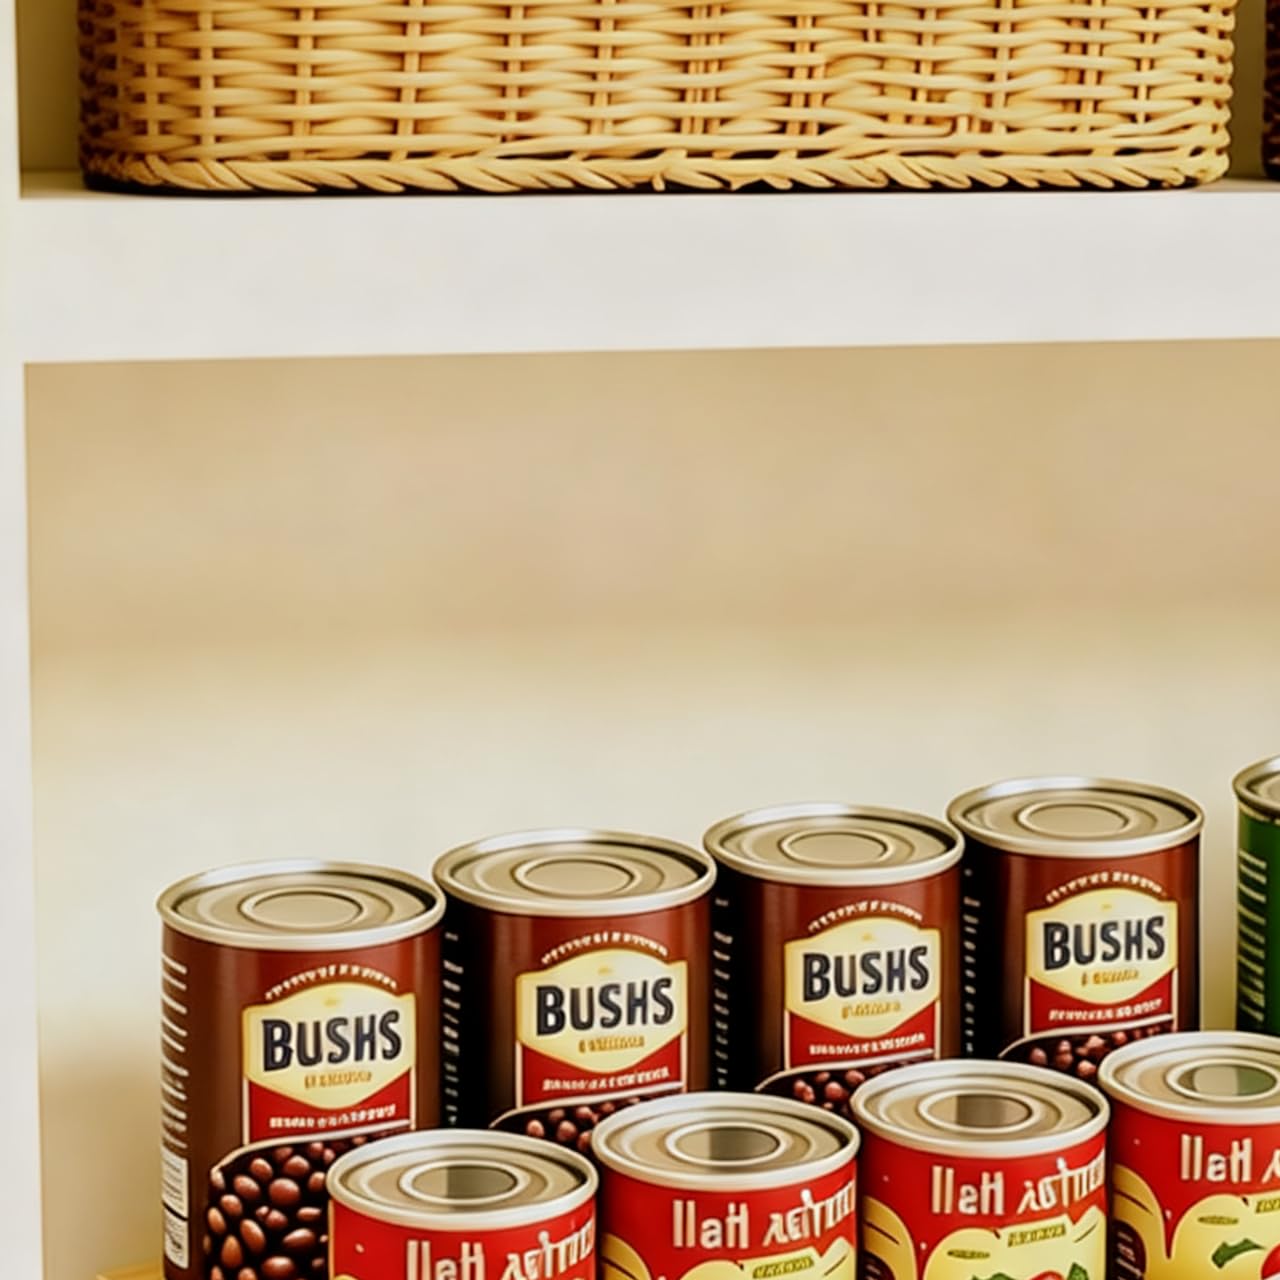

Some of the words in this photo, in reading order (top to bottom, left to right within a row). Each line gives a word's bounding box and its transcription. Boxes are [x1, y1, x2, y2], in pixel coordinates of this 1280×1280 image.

[1042, 915, 1166, 971] BUSHS
[802, 944, 930, 1003] BUSHS
[535, 977, 675, 1036] BUSHS
[261, 1009, 403, 1072] BUSHS
